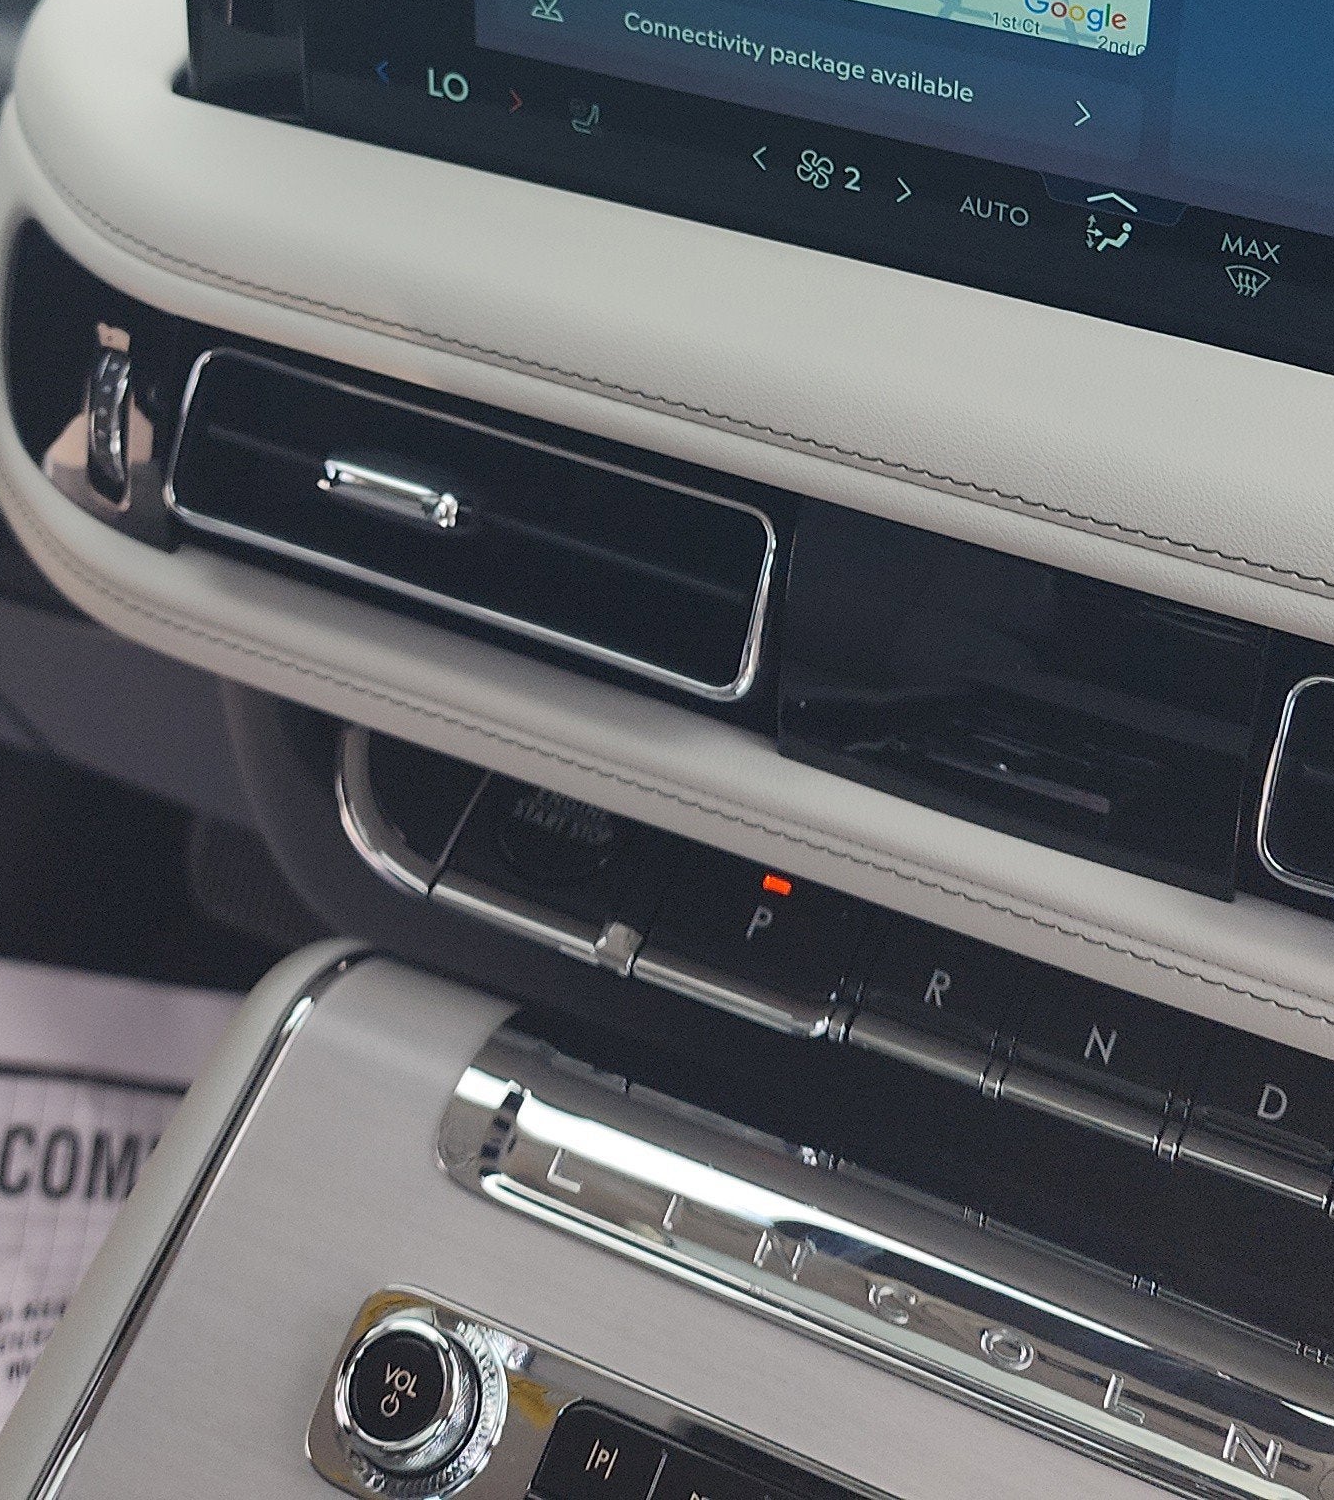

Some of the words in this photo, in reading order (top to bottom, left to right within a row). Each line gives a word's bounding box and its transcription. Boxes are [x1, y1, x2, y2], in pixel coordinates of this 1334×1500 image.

[992, 11, 1018, 30] 1st
[1021, 17, 1041, 36] Ct
[623, 10, 765, 62] Connectivity
[769, 43, 867, 82] package
[870, 64, 975, 104] available
[1097, 35, 1131, 56] 2nd
[426, 68, 469, 103] LO
[843, 165, 863, 193] 2
[959, 195, 1030, 228] AUTO
[1219, 231, 1282, 264] MAX
[745, 906, 772, 940] P
[922, 968, 952, 1007] R
[1084, 1026, 1118, 1065] N
[1258, 1084, 1288, 1121] D
[382, 1362, 418, 1398] VOL
